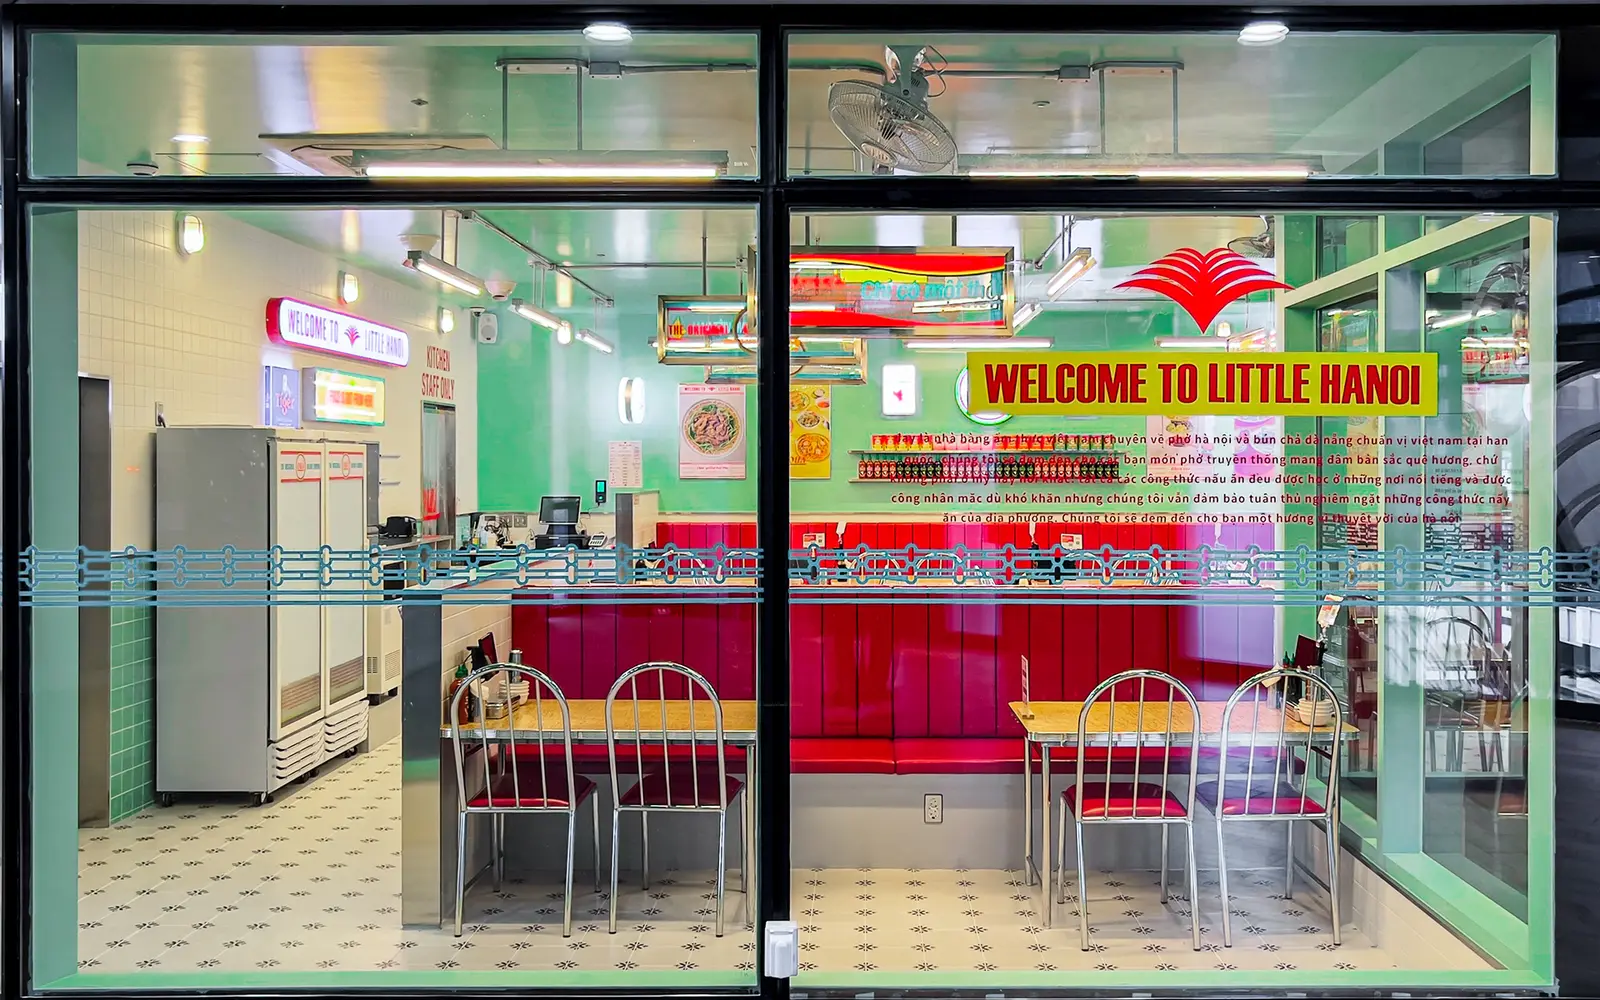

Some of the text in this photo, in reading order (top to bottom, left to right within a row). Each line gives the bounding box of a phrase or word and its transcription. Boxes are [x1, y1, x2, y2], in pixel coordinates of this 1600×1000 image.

[288, 308, 327, 341] WELCOME
[330, 319, 339, 344] TO
[364, 329, 384, 354] LITTLE
[426, 345, 451, 371] KITCHEN
[421, 372, 455, 400] STAFF ONLY
[984, 363, 1420, 405] WELCOME TO LITTLE HANOI
[1195, 433, 1209, 444] hà
[1254, 434, 1276, 444] bún
[1437, 437, 1463, 446] nam
[1467, 436, 1482, 448] tại
[1124, 455, 1146, 467] bạn
[1290, 456, 1323, 467] mang
[1406, 454, 1428, 467] quê
[1141, 474, 1170, 486] công
[891, 493, 920, 505] công
[1005, 492, 1027, 503] khó
[1065, 493, 1103, 506] nhưng
[1106, 492, 1144, 506] chúng
[1147, 493, 1164, 503] tôi
[1425, 493, 1454, 506] công
[1197, 513, 1218, 523] cho
